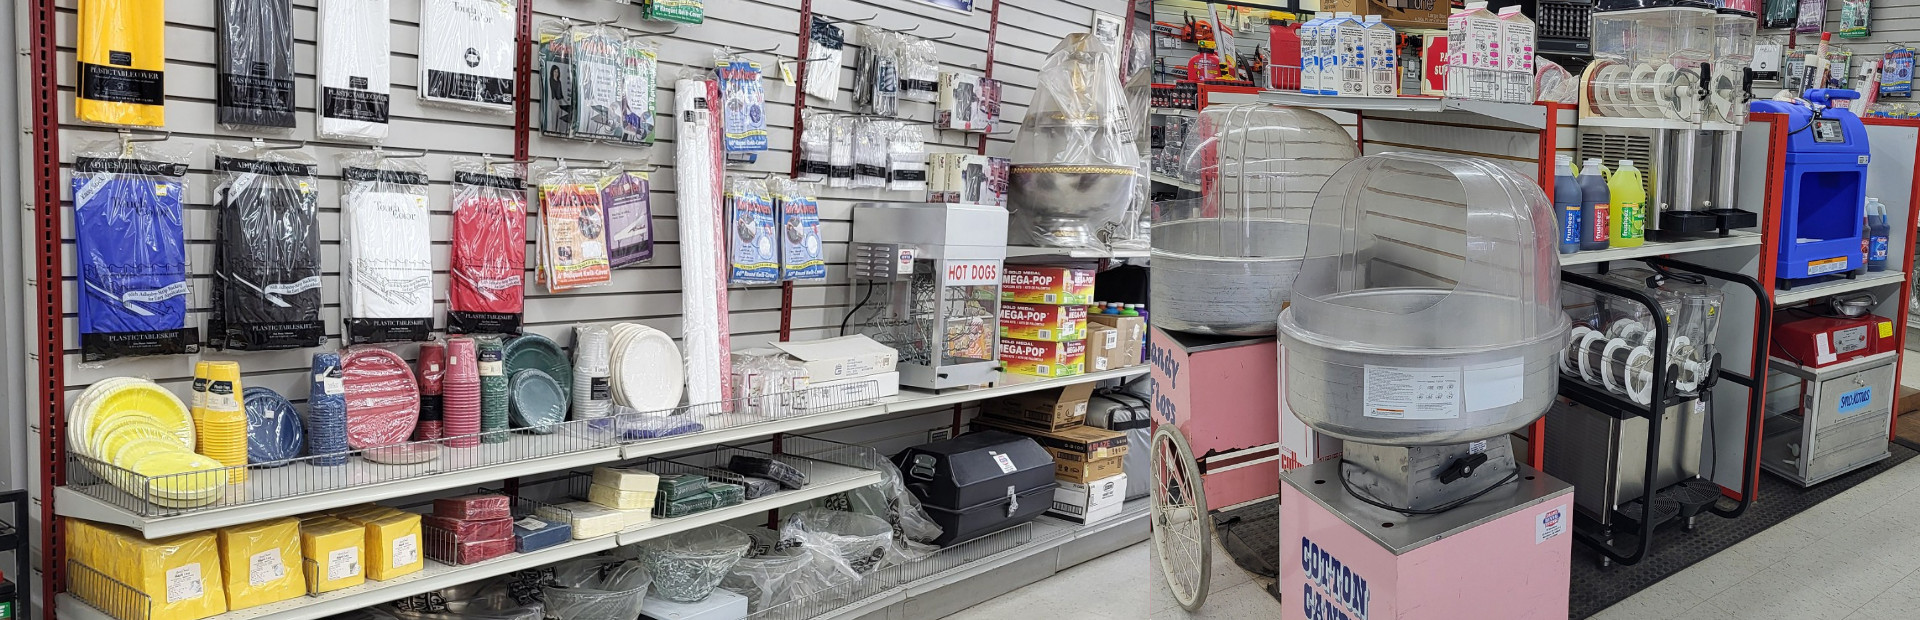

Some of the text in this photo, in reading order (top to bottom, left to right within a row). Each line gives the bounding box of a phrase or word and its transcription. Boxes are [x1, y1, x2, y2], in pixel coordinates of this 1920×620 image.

[948, 264, 996, 281] HOT DOGS
[1002, 274, 1053, 286] MEGA-POP
[1151, 342, 1180, 389] andy
[1301, 536, 1370, 620] COTTON
